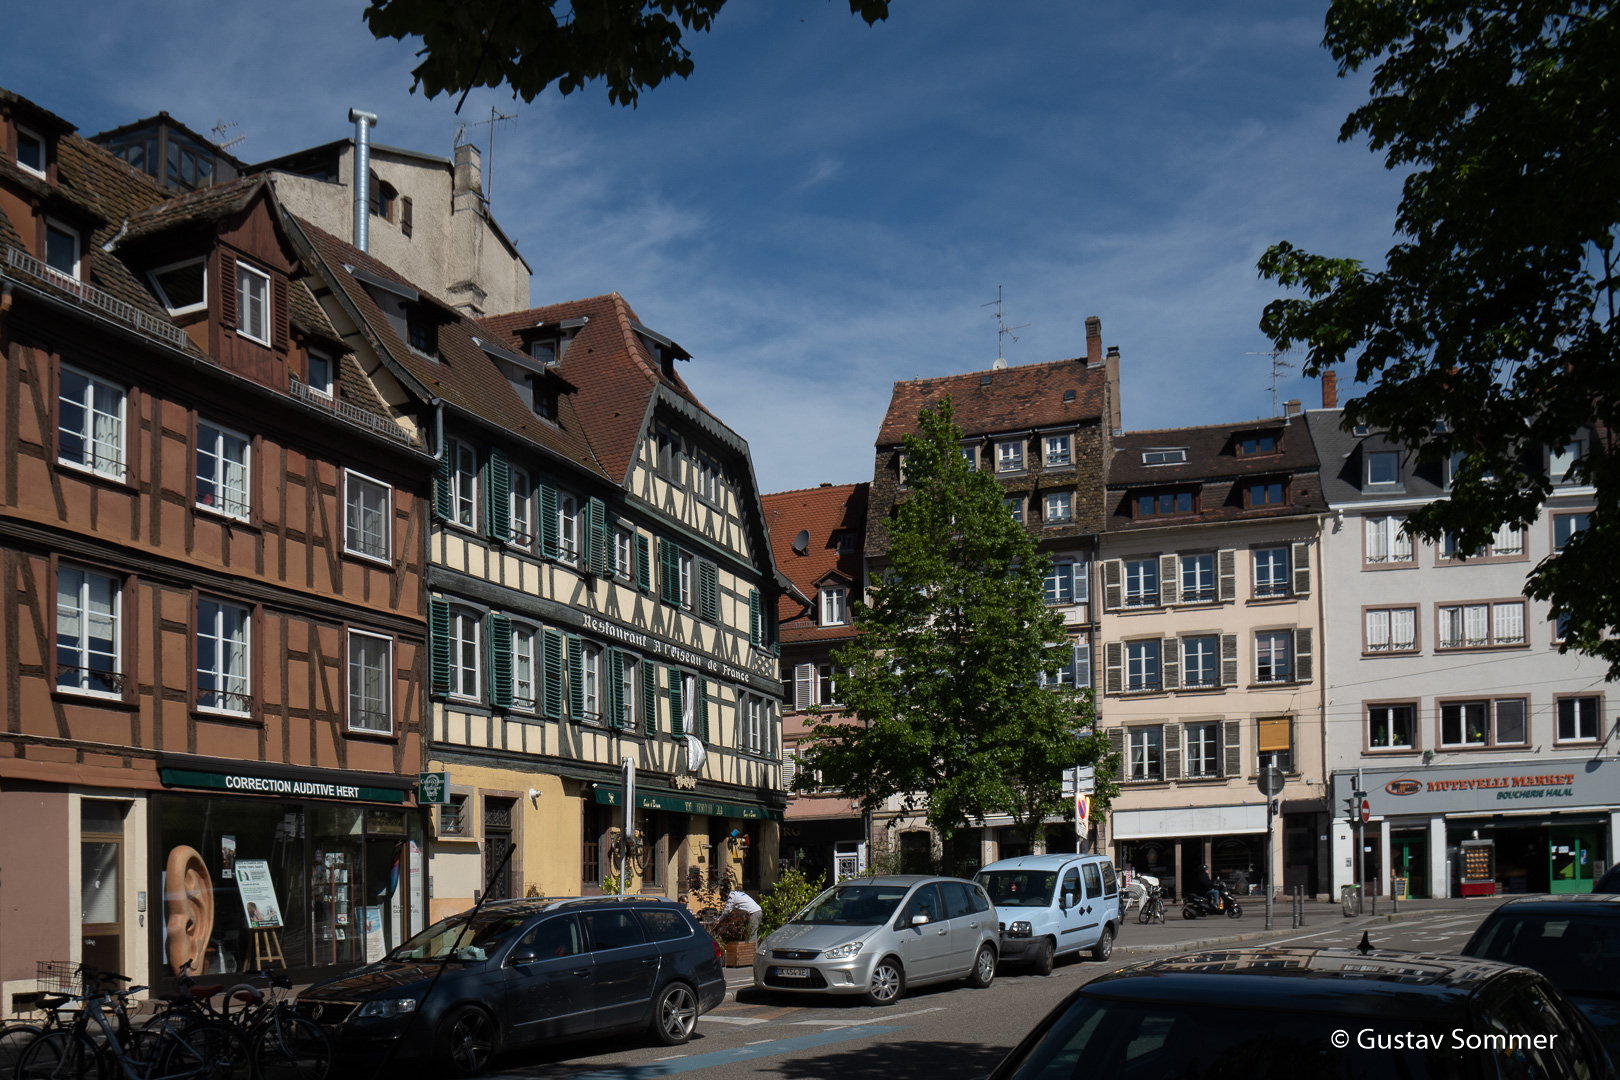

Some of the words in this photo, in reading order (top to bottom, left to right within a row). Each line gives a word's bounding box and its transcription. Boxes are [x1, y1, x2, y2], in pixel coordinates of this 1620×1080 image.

[582, 612, 647, 647] Restaurant
[653, 639, 661, 653] A
[707, 659, 717, 672] de
[722, 663, 750, 683] France
[225, 775, 291, 793] CORRECTION
[293, 781, 335, 796] AUDITIVE
[336, 785, 359, 798] HERT
[1426, 776, 1510, 793] MUTEVELLI
[1511, 773, 1575, 787] MARKET
[1496, 789, 1546, 800] BOUCHERIE
[1545, 787, 1574, 798] HALAL
